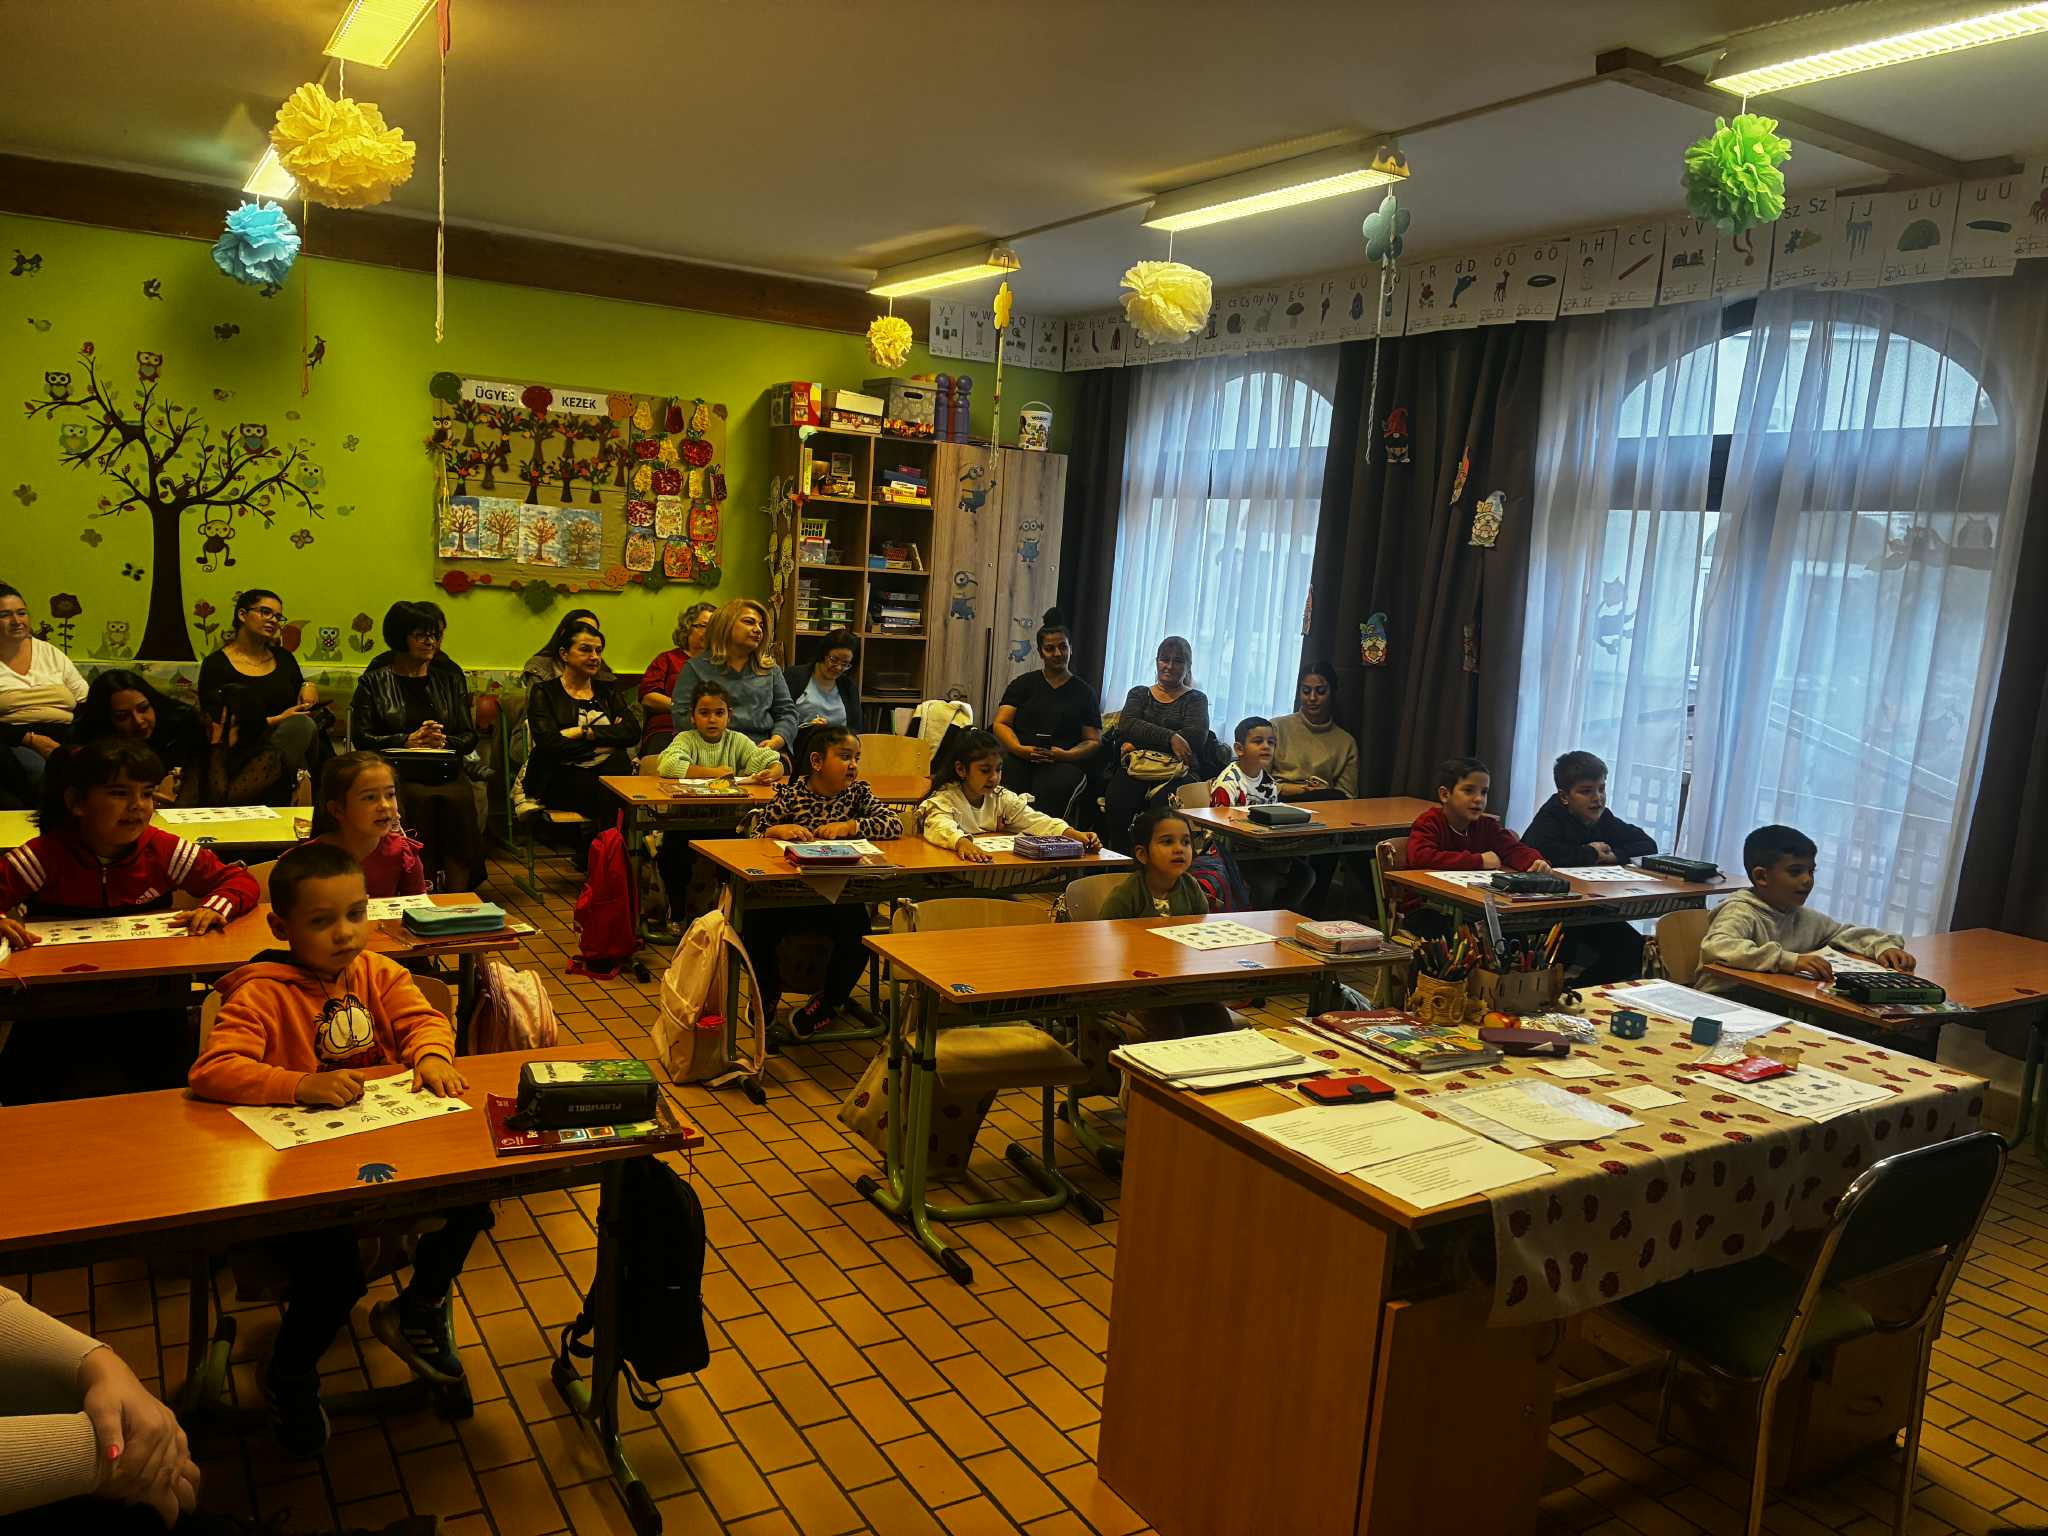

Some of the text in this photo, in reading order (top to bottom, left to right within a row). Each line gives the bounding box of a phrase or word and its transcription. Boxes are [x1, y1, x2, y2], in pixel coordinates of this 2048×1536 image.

[1977, 181, 2012, 201] u U
[1783, 197, 1829, 220] sz Sz
[1862, 199, 1873, 217] J
[1579, 237, 1604, 254] h H
[1642, 229, 1652, 244] C
[1429, 264, 1438, 280] R
[1455, 256, 1477, 274] d D
[474, 385, 598, 410] ÜGYES KEZEK
